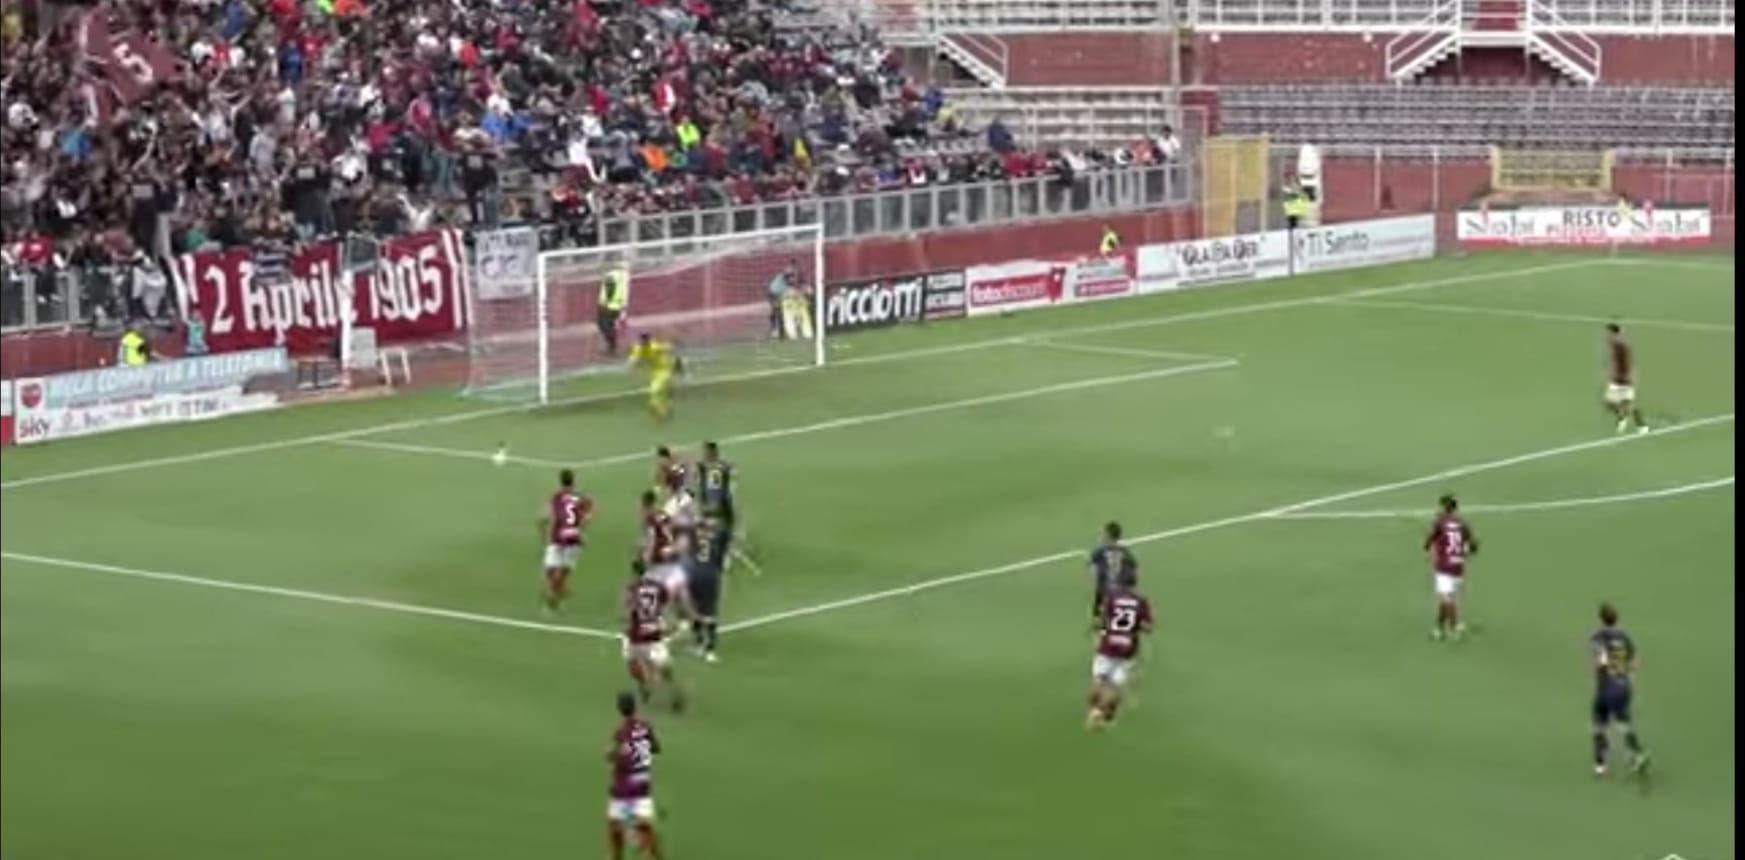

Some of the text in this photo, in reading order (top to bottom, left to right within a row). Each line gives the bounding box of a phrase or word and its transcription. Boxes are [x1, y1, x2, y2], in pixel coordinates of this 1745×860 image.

[204, 265, 235, 334] 2
[369, 245, 443, 320] 1905
[1110, 606, 1137, 631] 23
